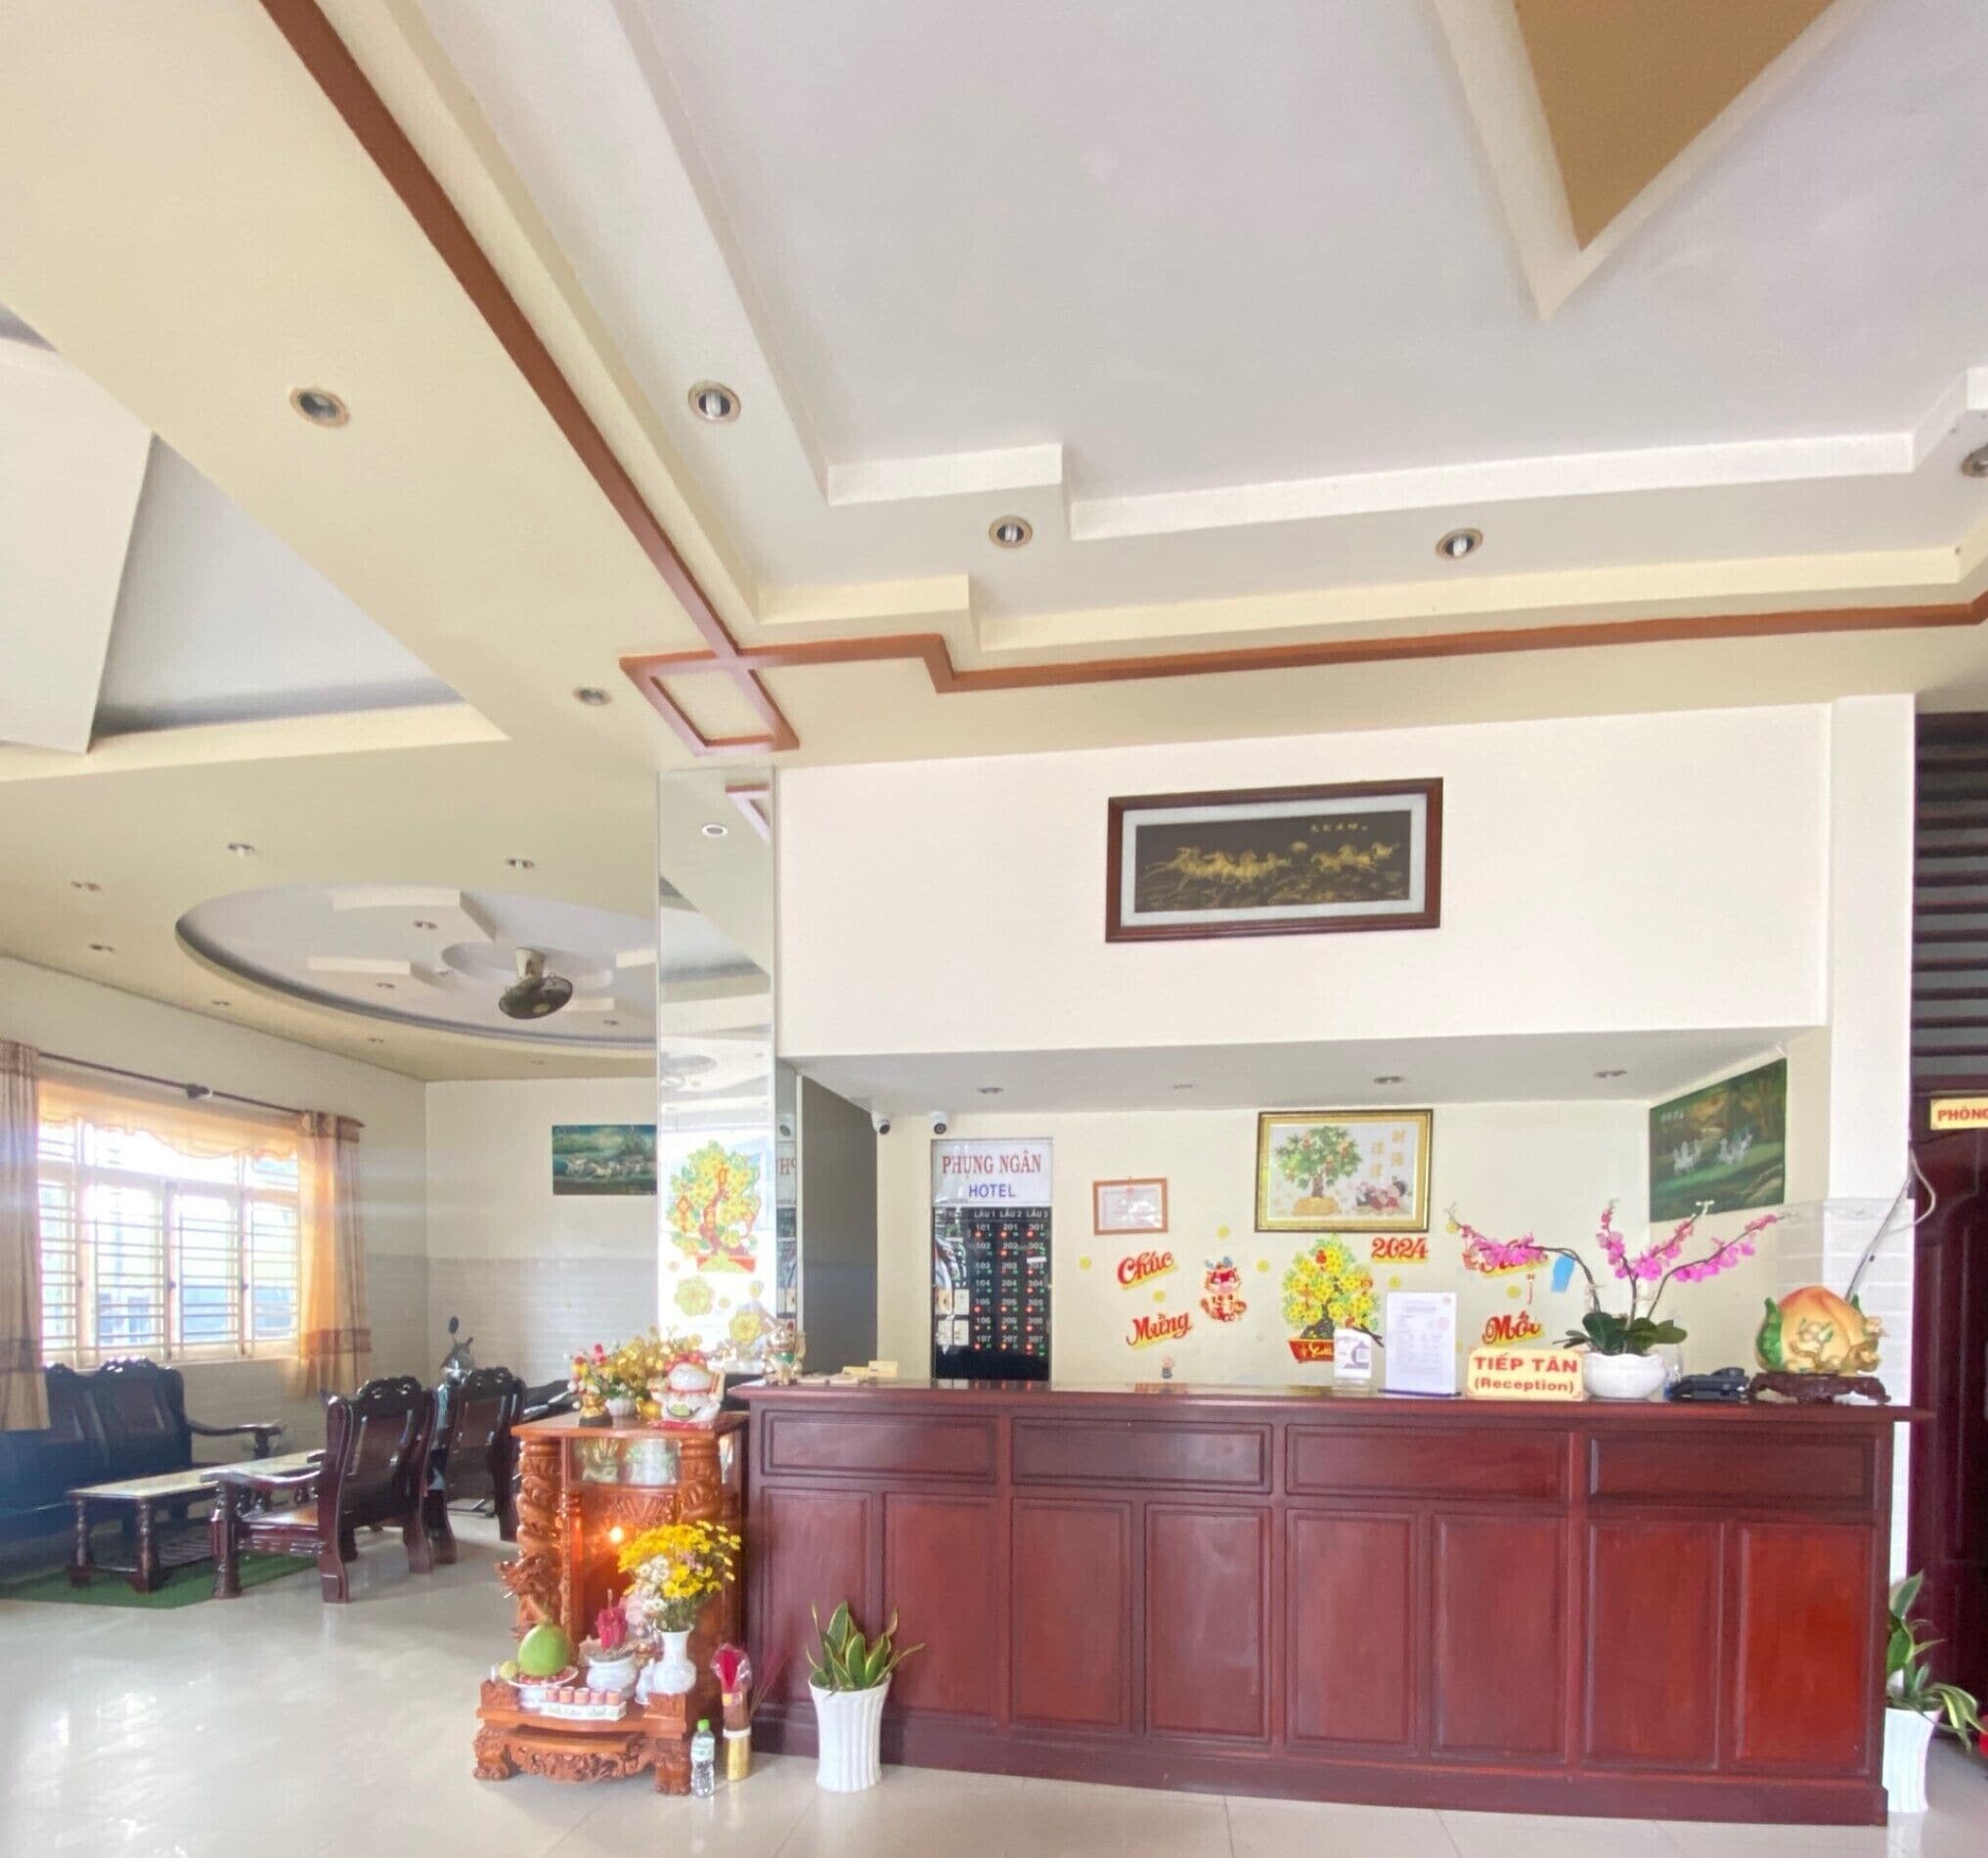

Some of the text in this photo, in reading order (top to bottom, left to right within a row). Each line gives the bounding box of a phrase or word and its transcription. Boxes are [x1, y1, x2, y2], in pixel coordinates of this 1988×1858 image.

[999, 1149, 1041, 1173] NGÂN
[968, 1183, 1017, 1198] HOTEL
[1371, 1236, 1429, 1258] 2024
[1118, 1250, 1174, 1285] Chúc
[1126, 1312, 1192, 1346] Mừng
[1481, 1310, 1542, 1346] Mới
[1474, 1351, 1578, 1373] TIẾP TÂN
[1475, 1376, 1574, 1394] (Reception)
